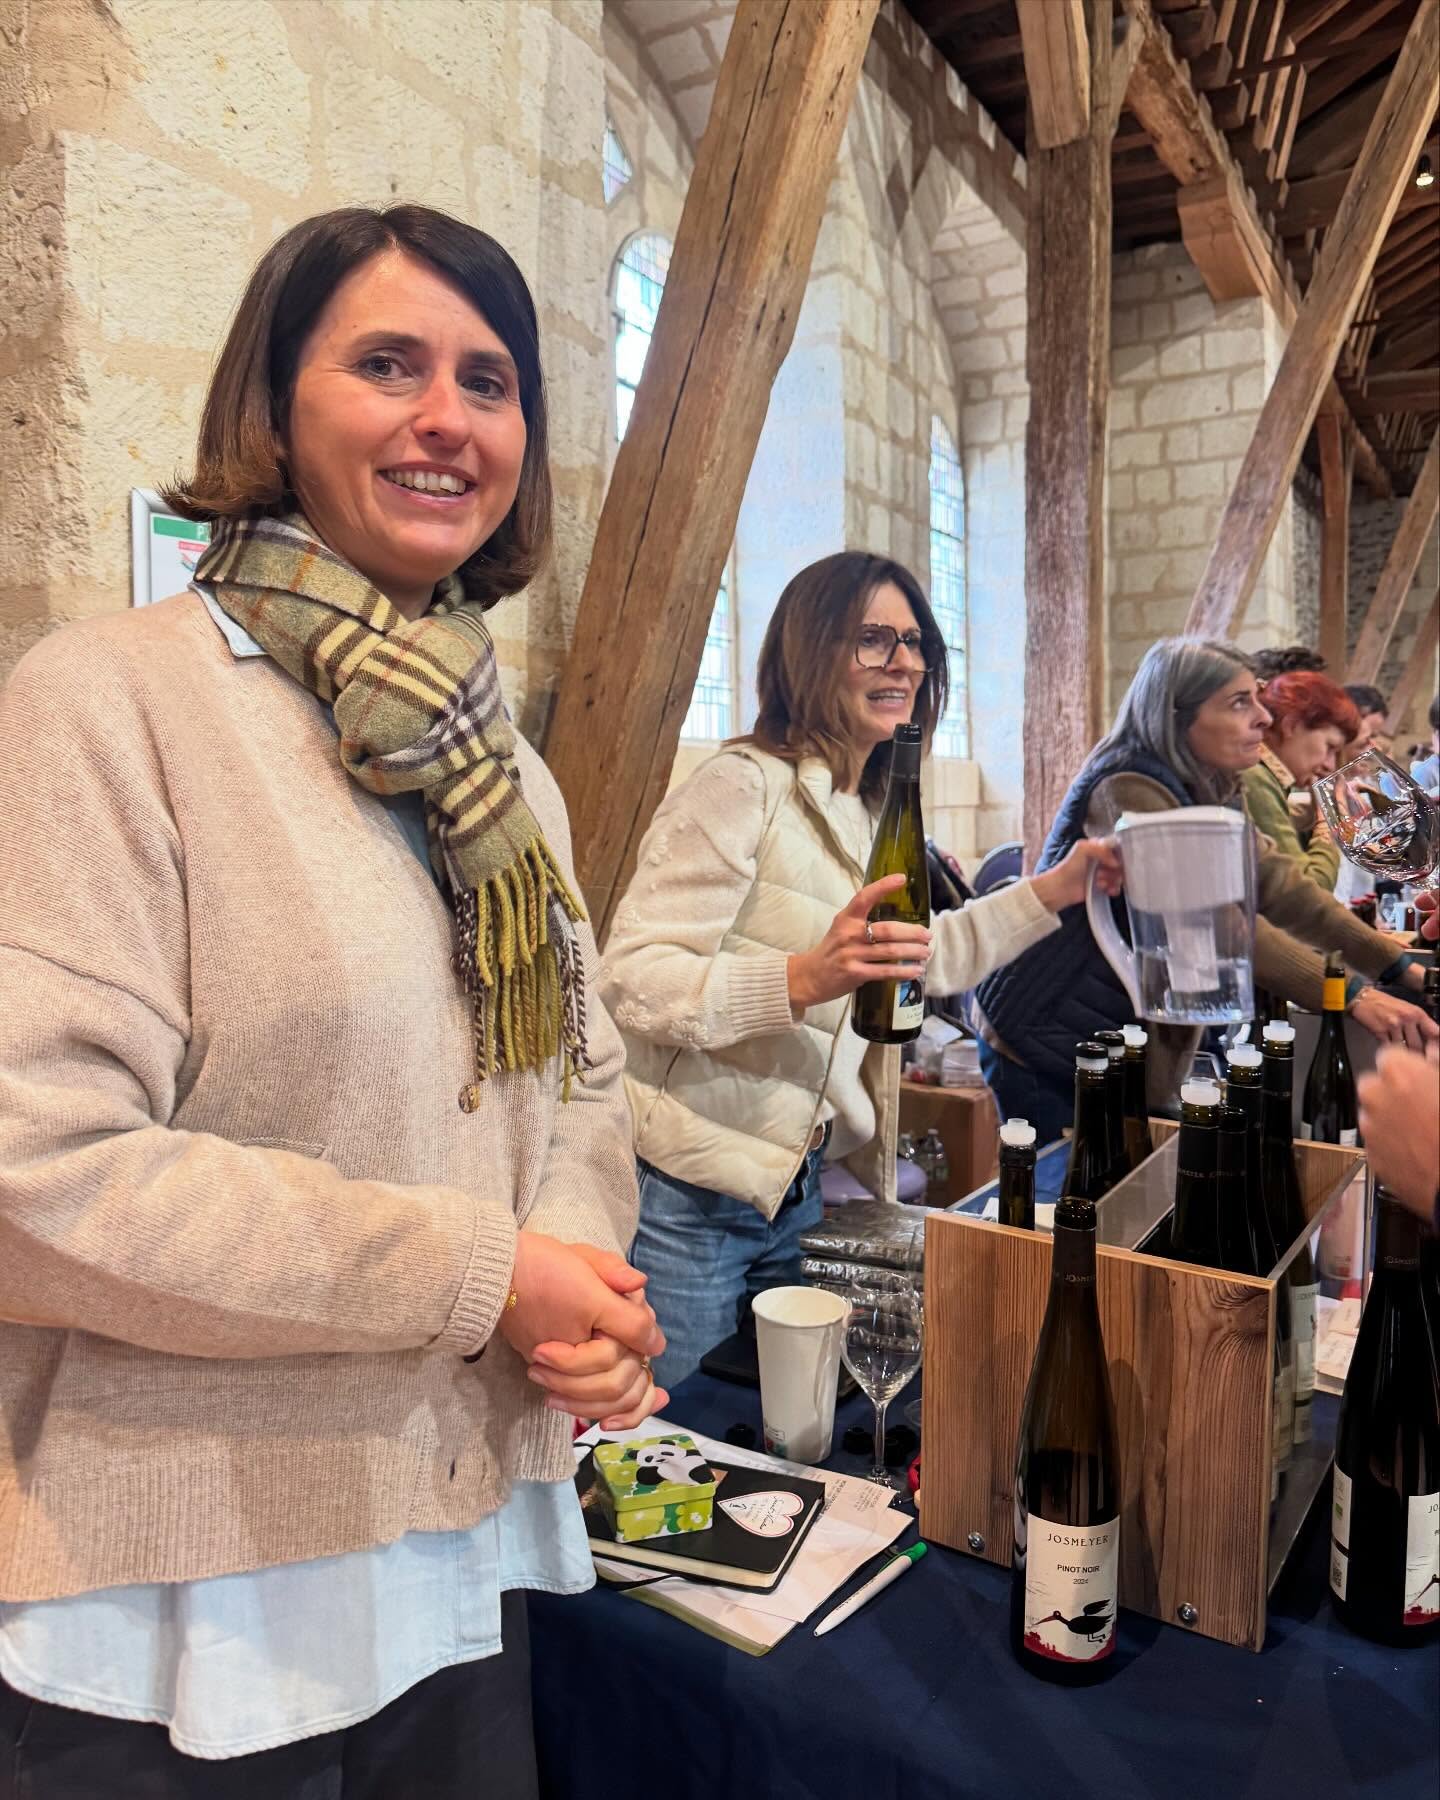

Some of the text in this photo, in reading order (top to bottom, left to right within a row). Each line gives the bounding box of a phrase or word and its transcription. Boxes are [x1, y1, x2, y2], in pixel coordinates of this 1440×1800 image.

[1047, 1533, 1109, 1547] JOSMEYER
[1057, 1564, 1100, 1573] PINOT NOIR
